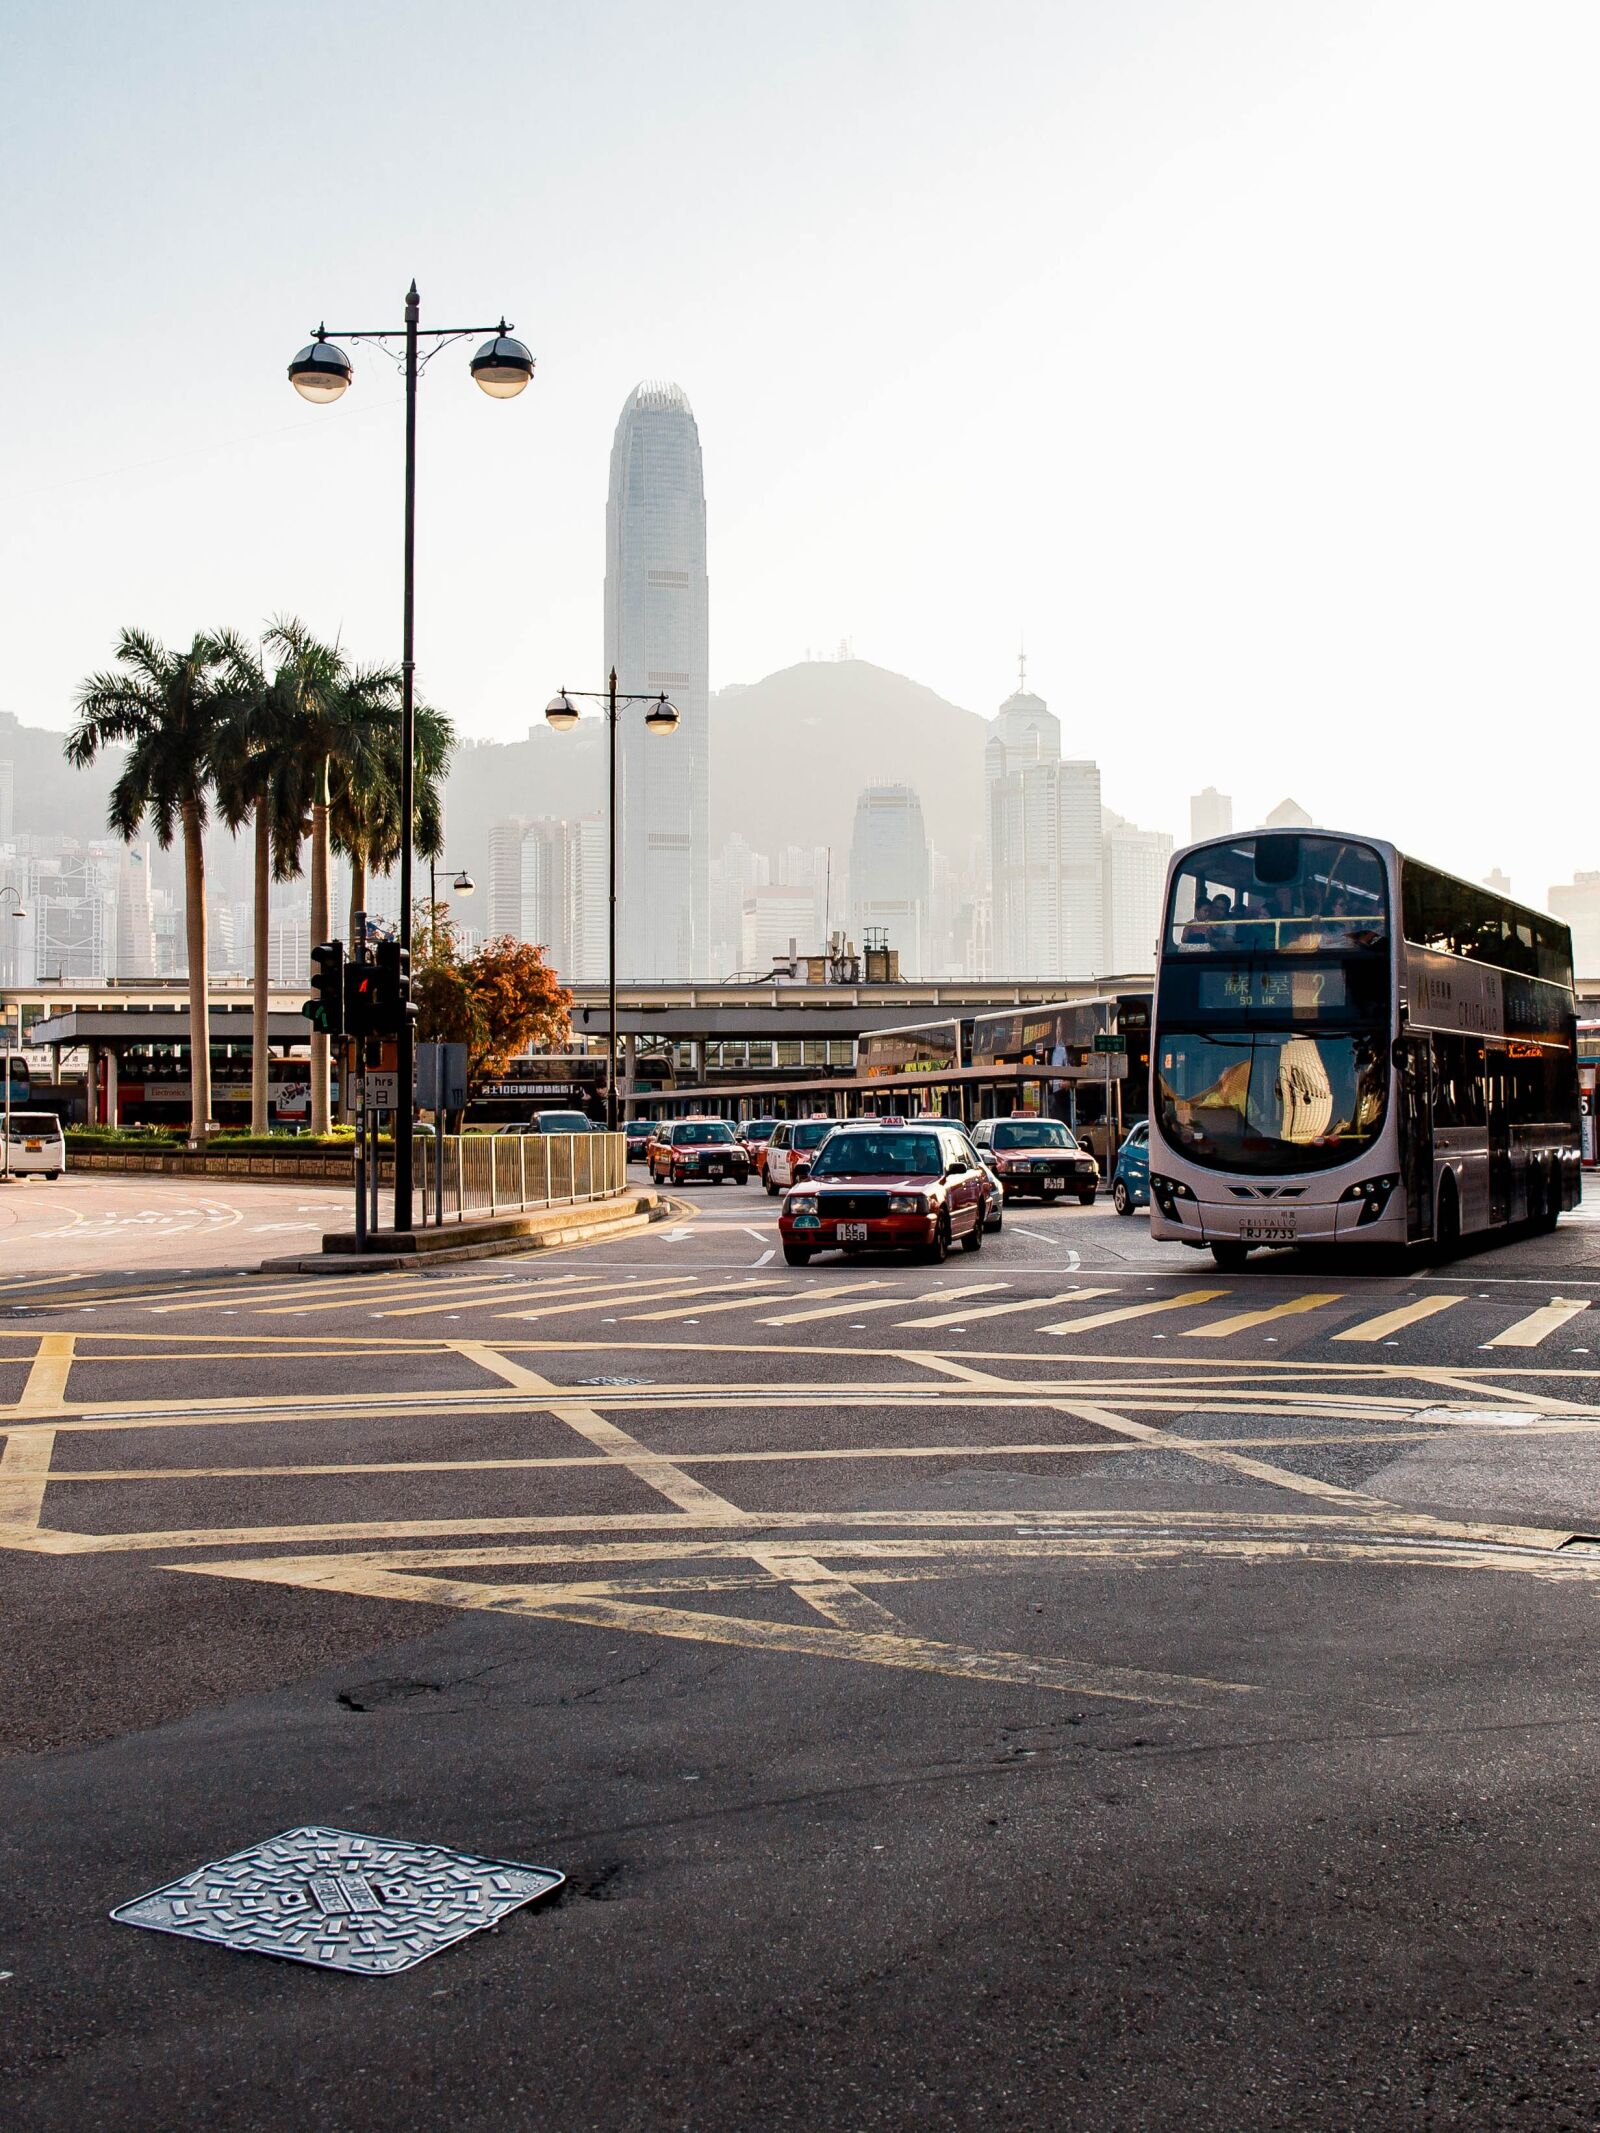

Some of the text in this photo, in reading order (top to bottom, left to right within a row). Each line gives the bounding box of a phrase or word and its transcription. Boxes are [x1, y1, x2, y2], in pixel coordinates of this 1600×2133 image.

[1312, 973, 1326, 1004] 2
[1239, 996, 1276, 1006] SO UK
[374, 1076, 393, 1087] hrs
[151, 1087, 186, 1097] Electronics
[845, 1223, 858, 1232] KC
[1239, 1218, 1297, 1227] CRISTALLO
[840, 1231, 865, 1240] 1558
[1247, 1228, 1294, 1239] RJ 2733
